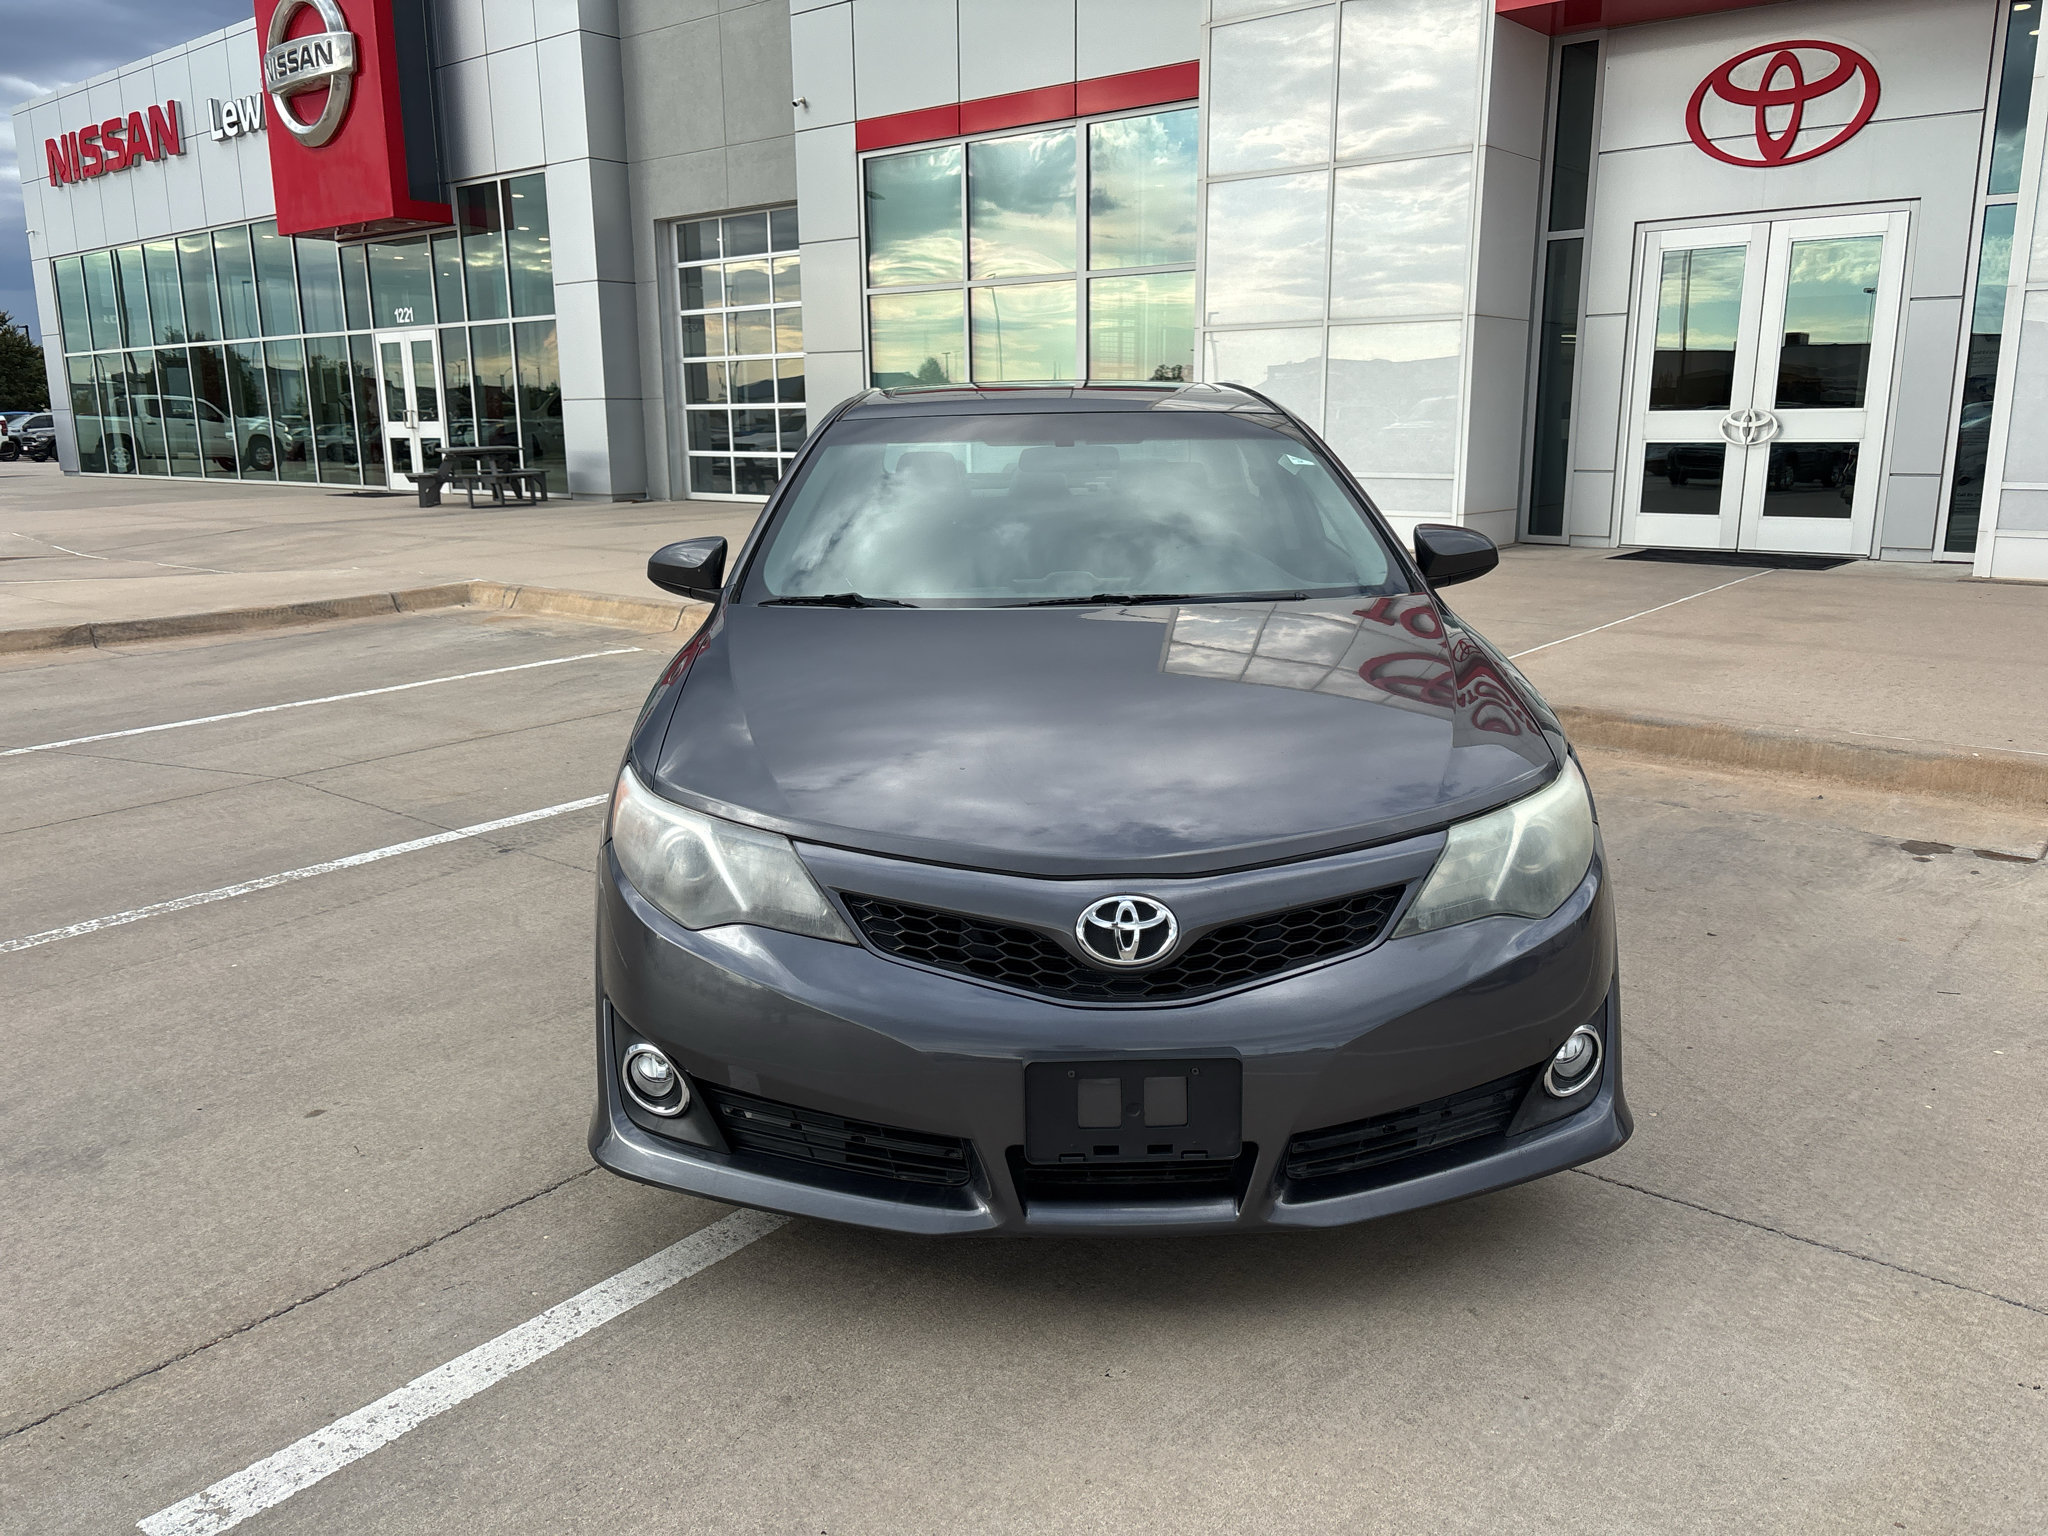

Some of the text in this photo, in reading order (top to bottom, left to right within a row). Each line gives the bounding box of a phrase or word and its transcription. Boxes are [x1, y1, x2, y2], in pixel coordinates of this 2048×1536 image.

[265, 40, 333, 83] NISSAN
[45, 91, 264, 187] NISSAN Lew
[394, 306, 414, 324] 1221
